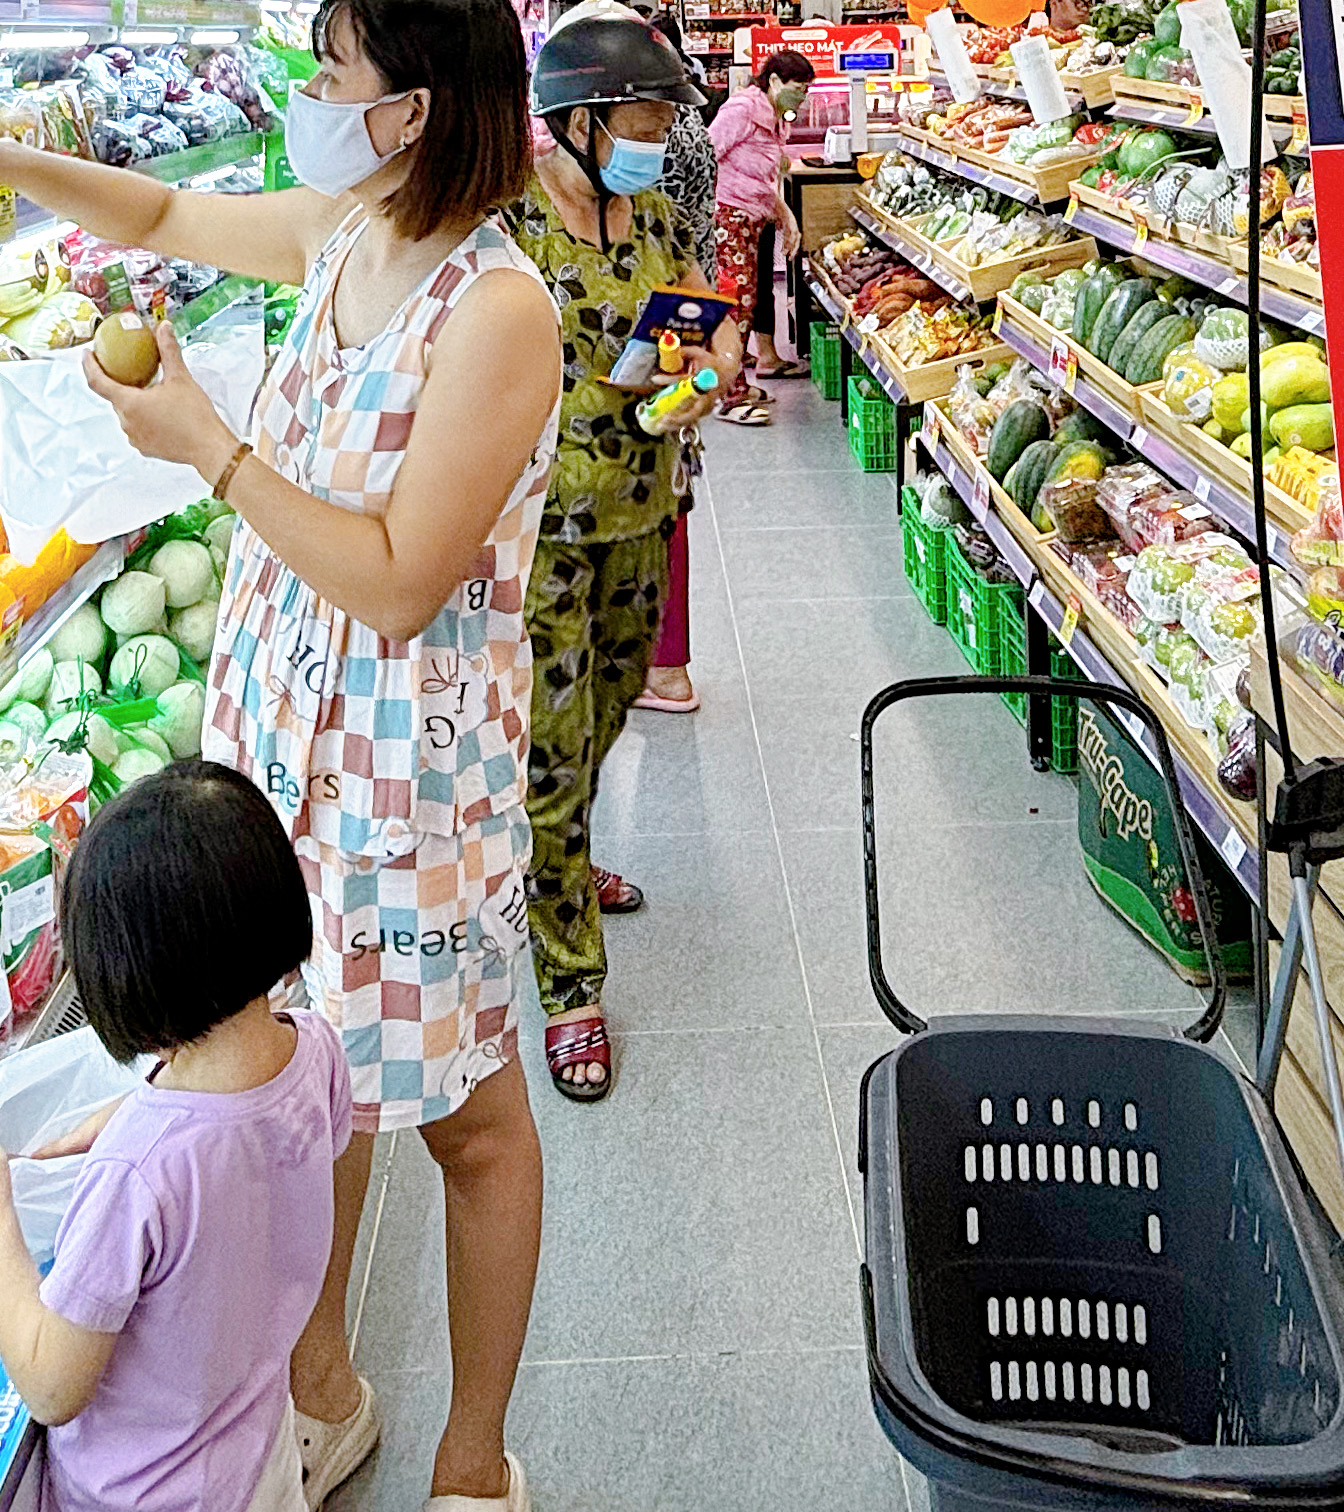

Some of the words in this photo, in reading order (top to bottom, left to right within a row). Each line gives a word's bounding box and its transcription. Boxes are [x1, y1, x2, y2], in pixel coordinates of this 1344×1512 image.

[788, 42, 814, 53] HEO
[817, 39, 844, 53] MÁT
[1077, 707, 1154, 841] Tru-Cape
